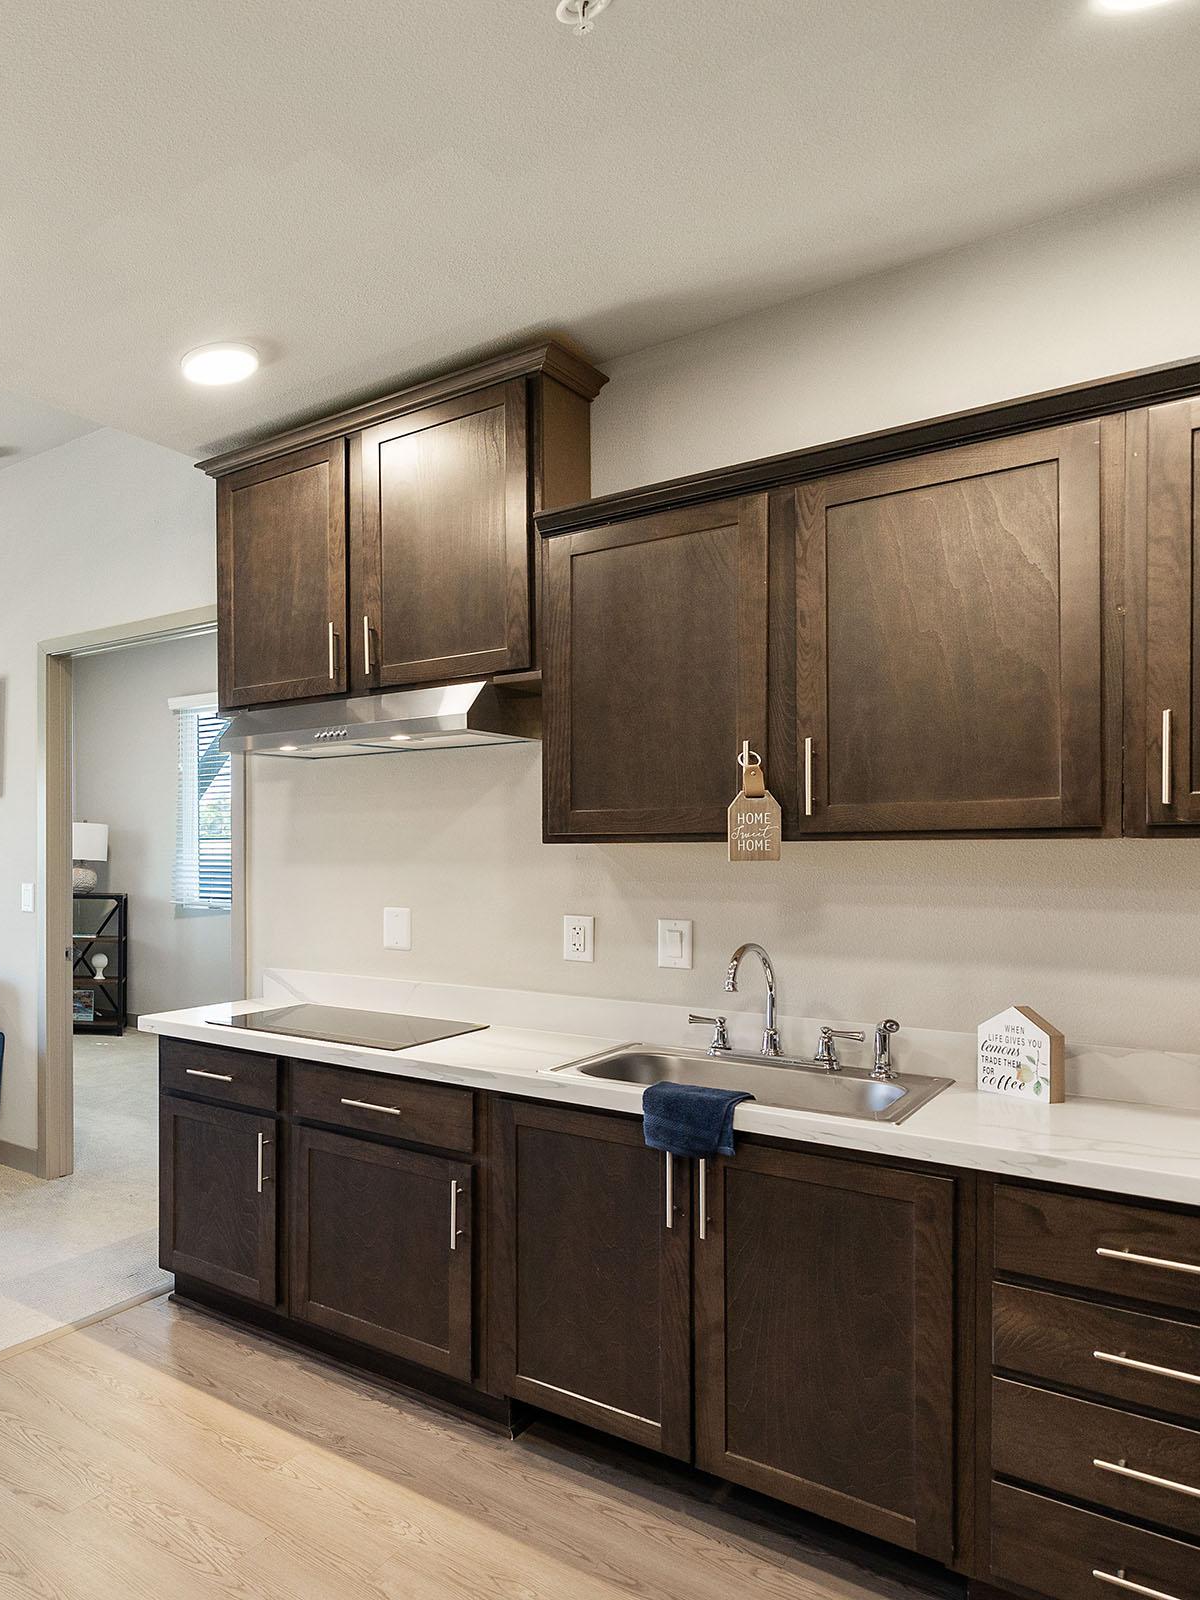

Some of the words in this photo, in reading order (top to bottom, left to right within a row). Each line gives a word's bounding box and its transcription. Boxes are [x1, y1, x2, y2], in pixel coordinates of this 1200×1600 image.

[737, 812, 771, 825] HOME
[737, 839, 771, 852] HOME
[1004, 1024, 1025, 1035] WHEN
[988, 1033, 1003, 1043] LIFE
[1005, 1036, 1025, 1047] GIVES
[1027, 1039, 1042, 1049] YOU
[981, 1040, 1020, 1057] lemons
[981, 1055, 1002, 1066] TRADE
[1004, 1059, 1022, 1069] THEM
[983, 1066, 995, 1075] FOR
[981, 1074, 1026, 1091] coffee
